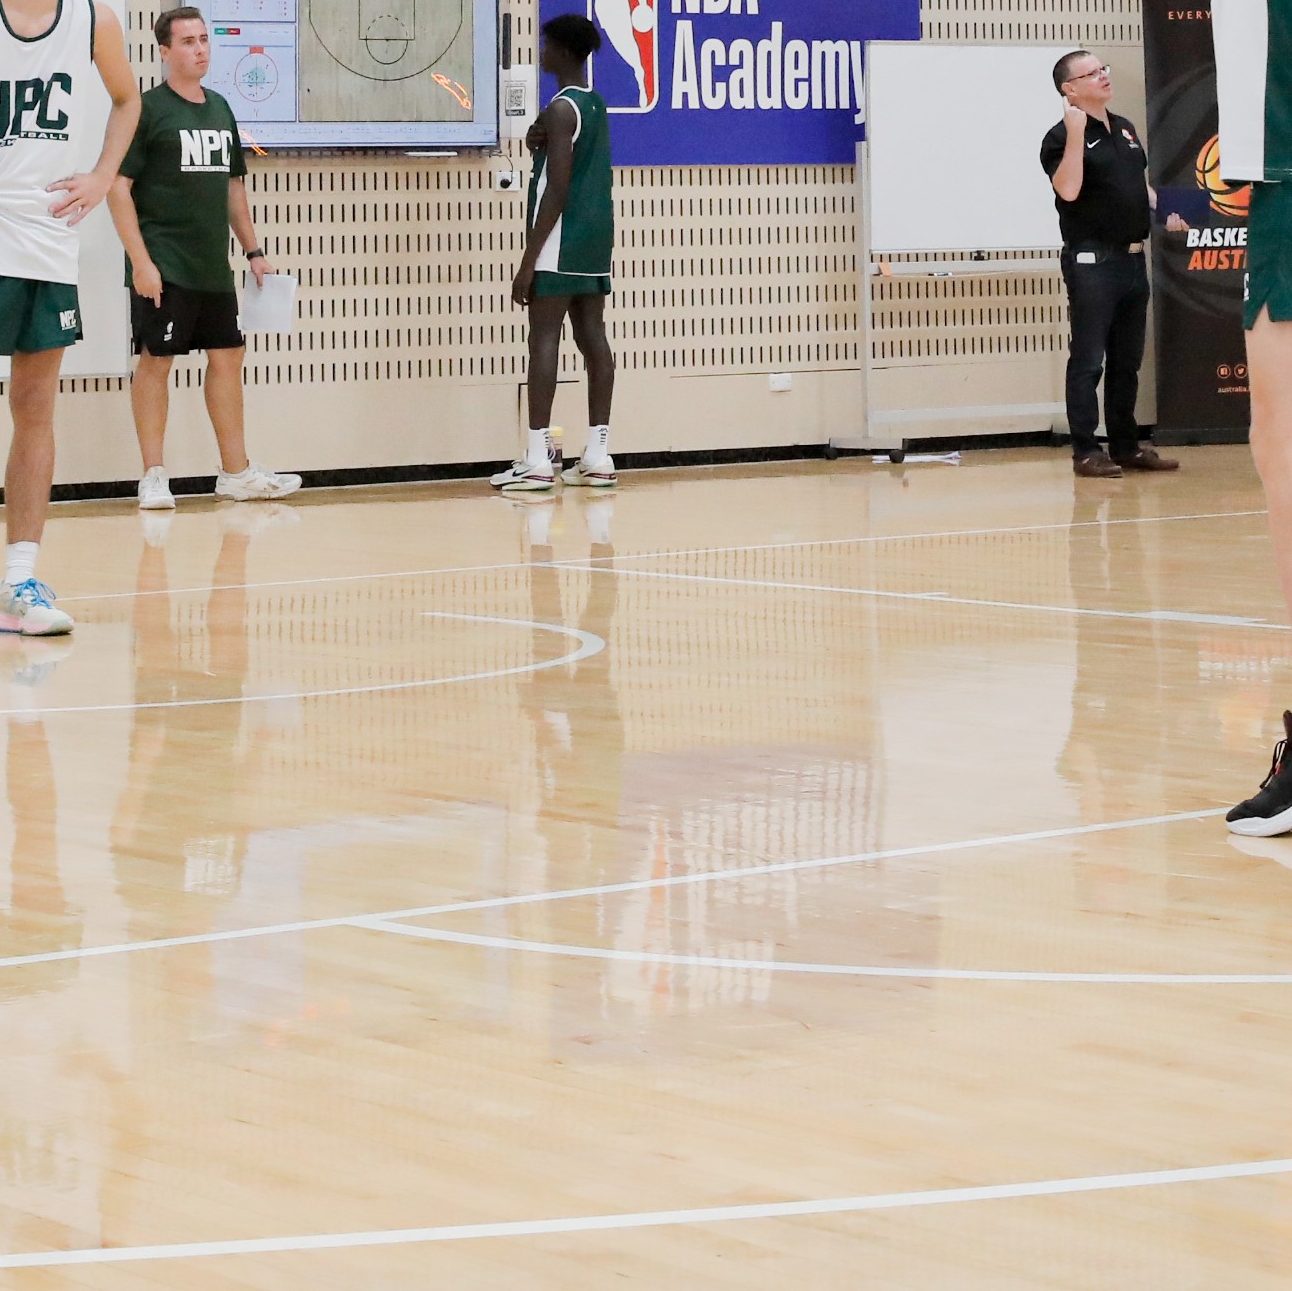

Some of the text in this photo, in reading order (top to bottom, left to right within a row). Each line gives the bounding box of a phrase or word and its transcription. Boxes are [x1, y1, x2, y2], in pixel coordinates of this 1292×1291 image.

[1168, 10, 1213, 20] EVERY
[179, 129, 233, 166] NPC
[1187, 227, 1248, 248] BASKE
[59, 309, 77, 328] NPC
